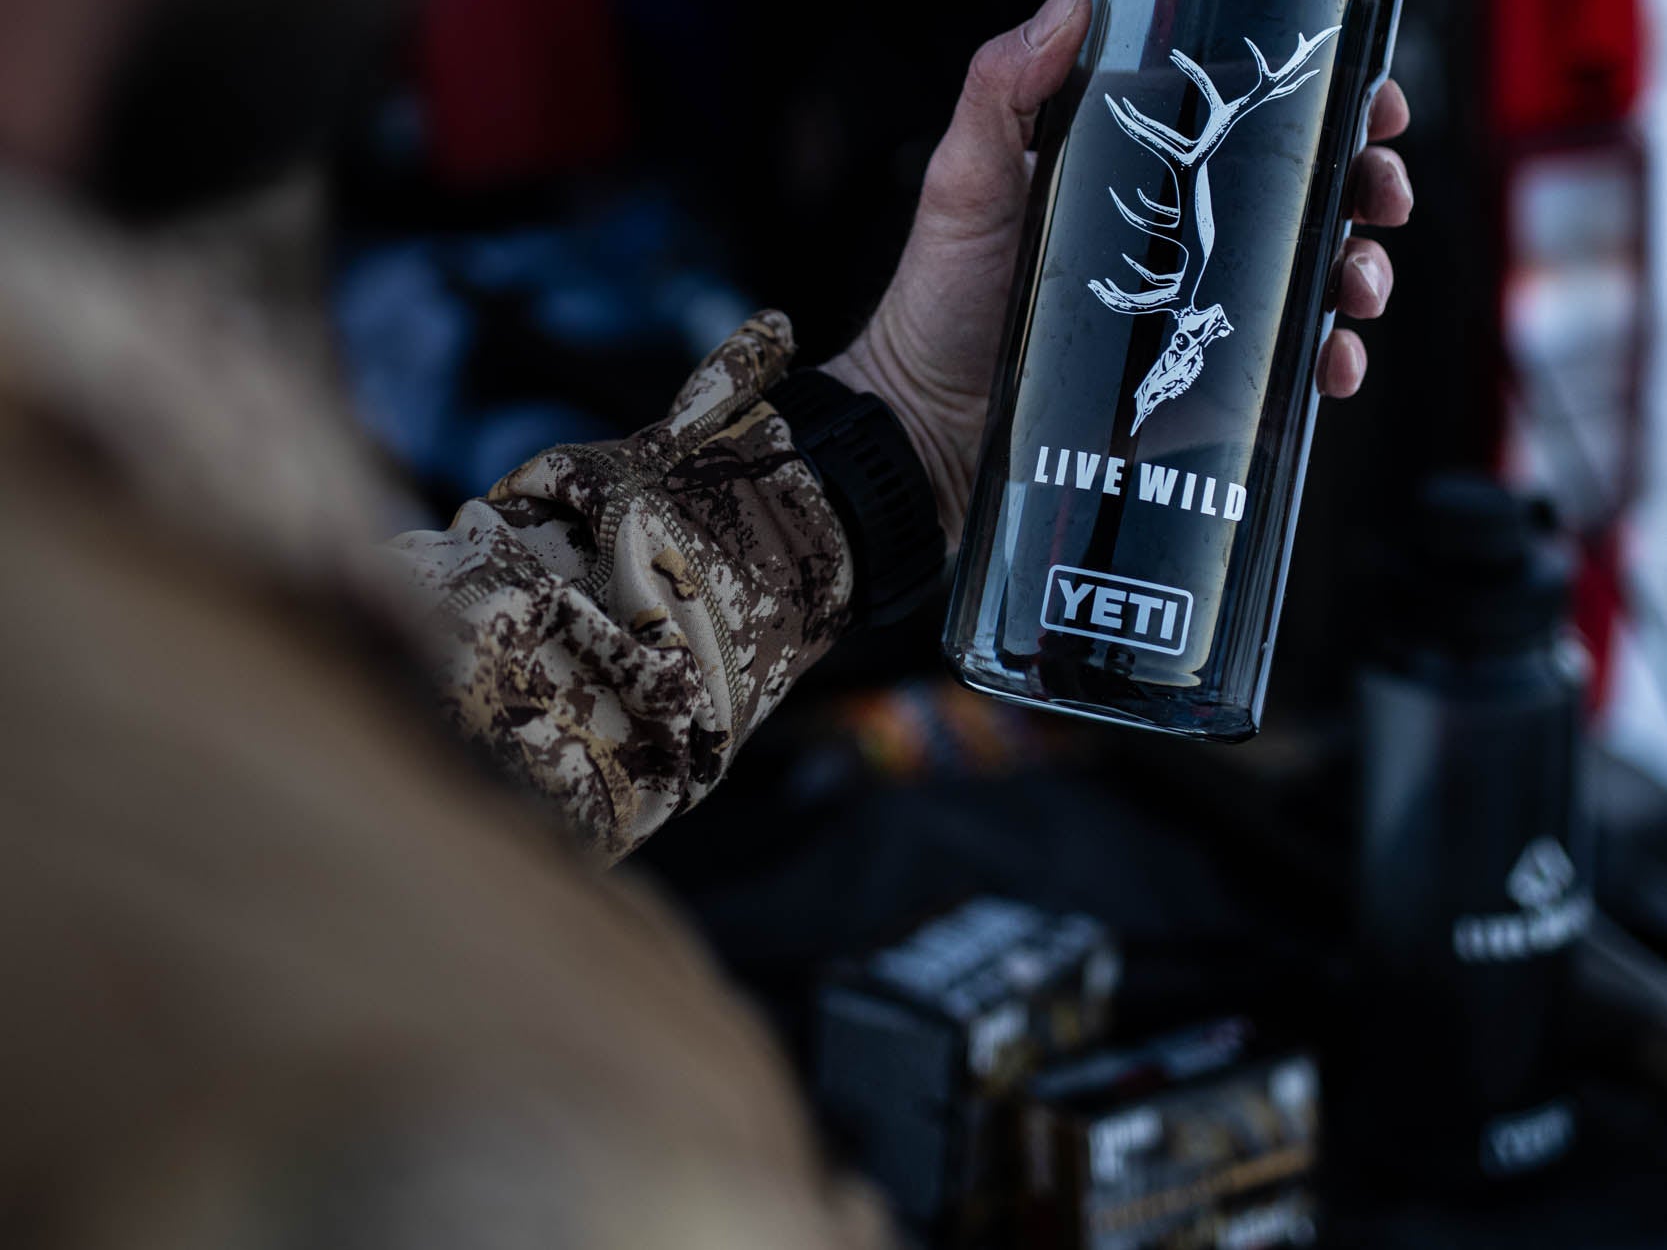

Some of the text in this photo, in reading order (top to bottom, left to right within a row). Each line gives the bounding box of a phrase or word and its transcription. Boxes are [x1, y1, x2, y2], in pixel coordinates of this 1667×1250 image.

[1034, 446, 1248, 522] LIVE WILD
[1057, 578, 1179, 640] YETI
